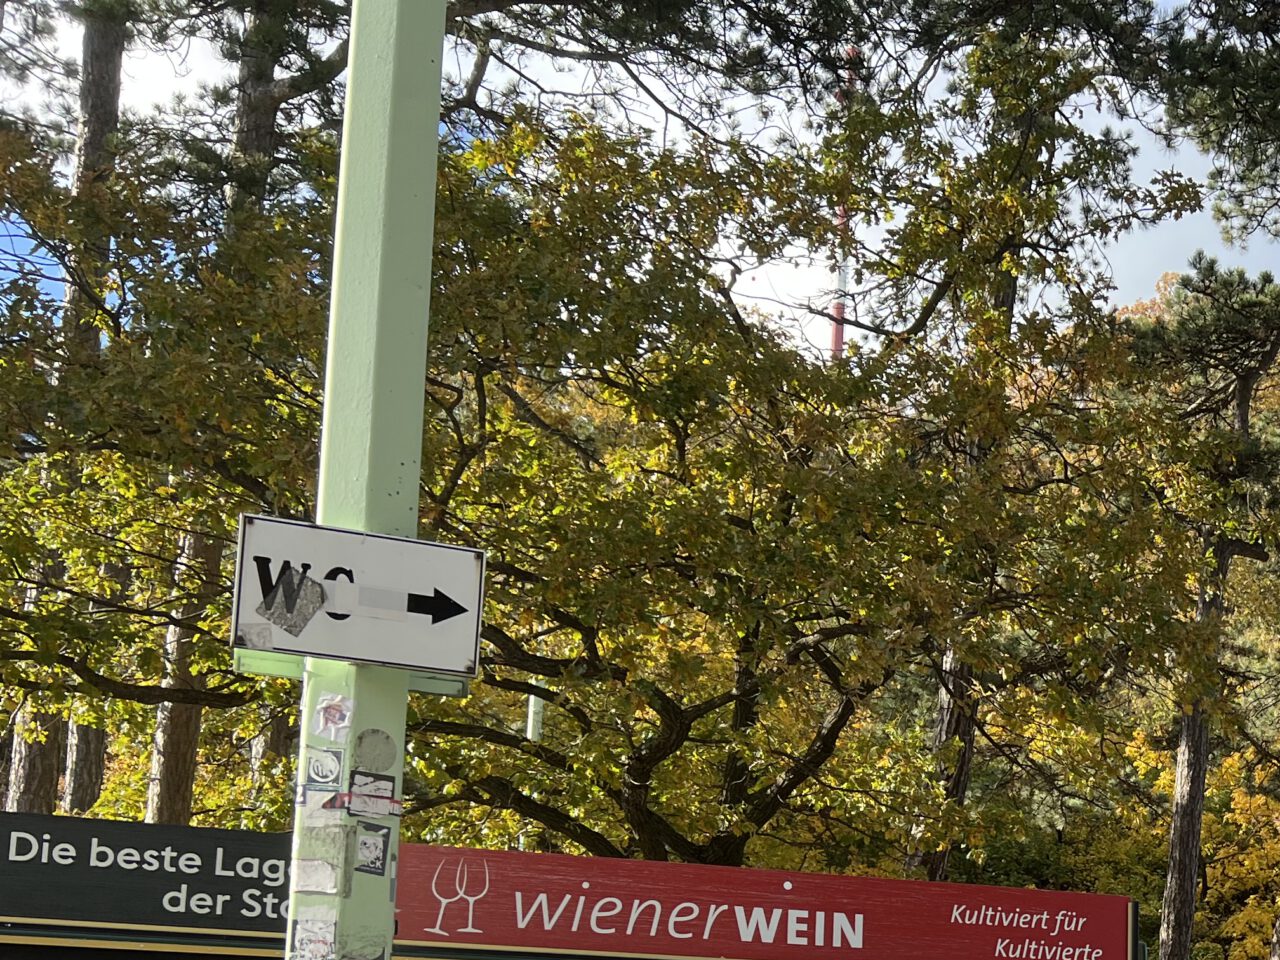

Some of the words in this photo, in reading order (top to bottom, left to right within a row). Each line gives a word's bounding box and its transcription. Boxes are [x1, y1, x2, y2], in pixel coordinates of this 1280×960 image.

[8, 831, 77, 865] Die
[89, 837, 202, 874] beste
[215, 847, 292, 887] Lag
[162, 883, 231, 915] der
[514, 881, 864, 949] wienerWEIN
[950, 904, 1050, 929] Kultiviert
[1050, 910, 1087, 936] für
